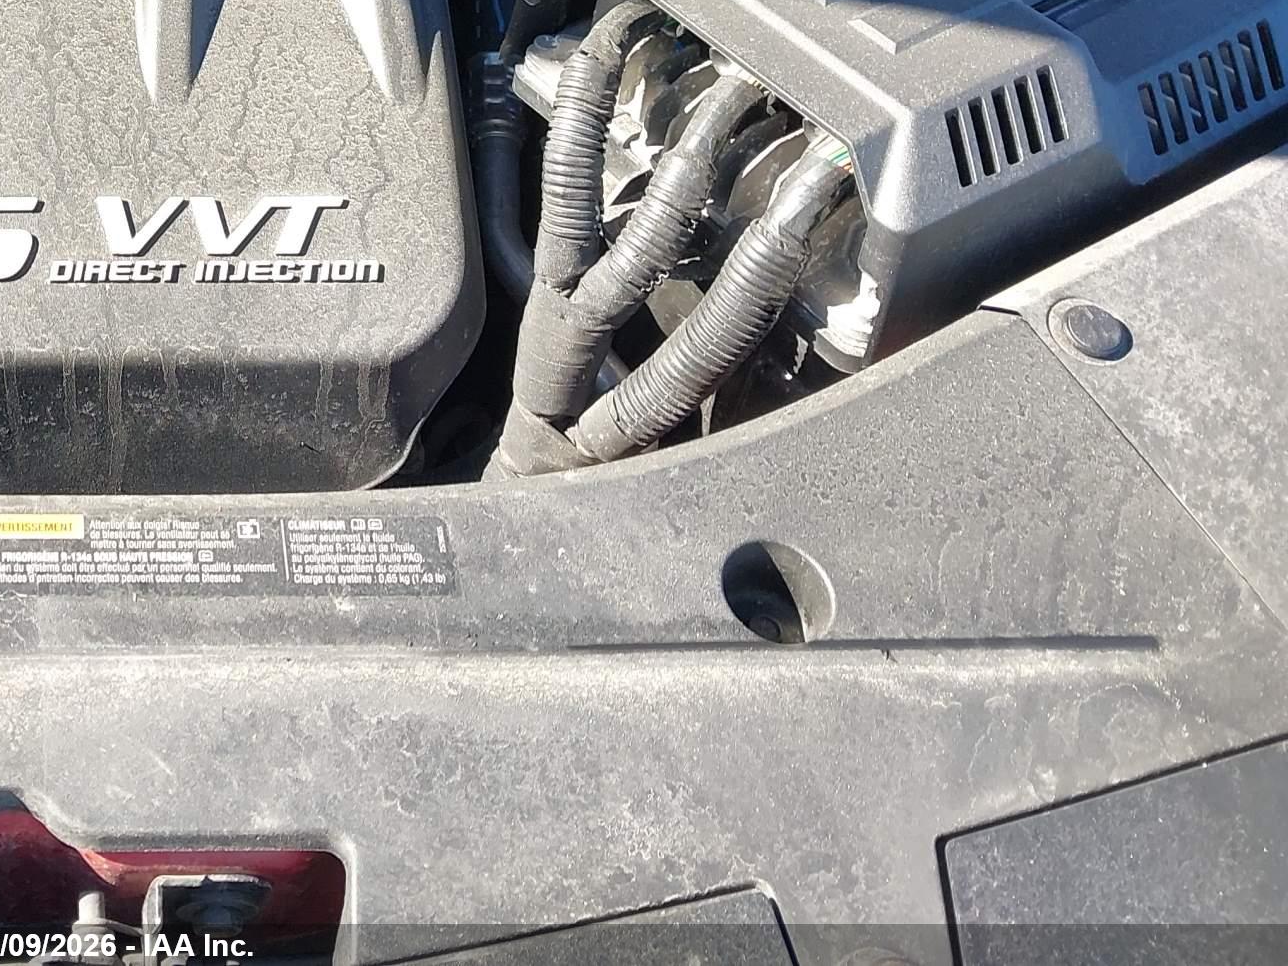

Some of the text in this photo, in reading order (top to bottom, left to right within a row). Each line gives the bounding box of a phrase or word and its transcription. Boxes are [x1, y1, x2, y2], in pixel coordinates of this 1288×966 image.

[95, 196, 350, 257] VVT
[50, 260, 386, 284] DIRECT INJECTION
